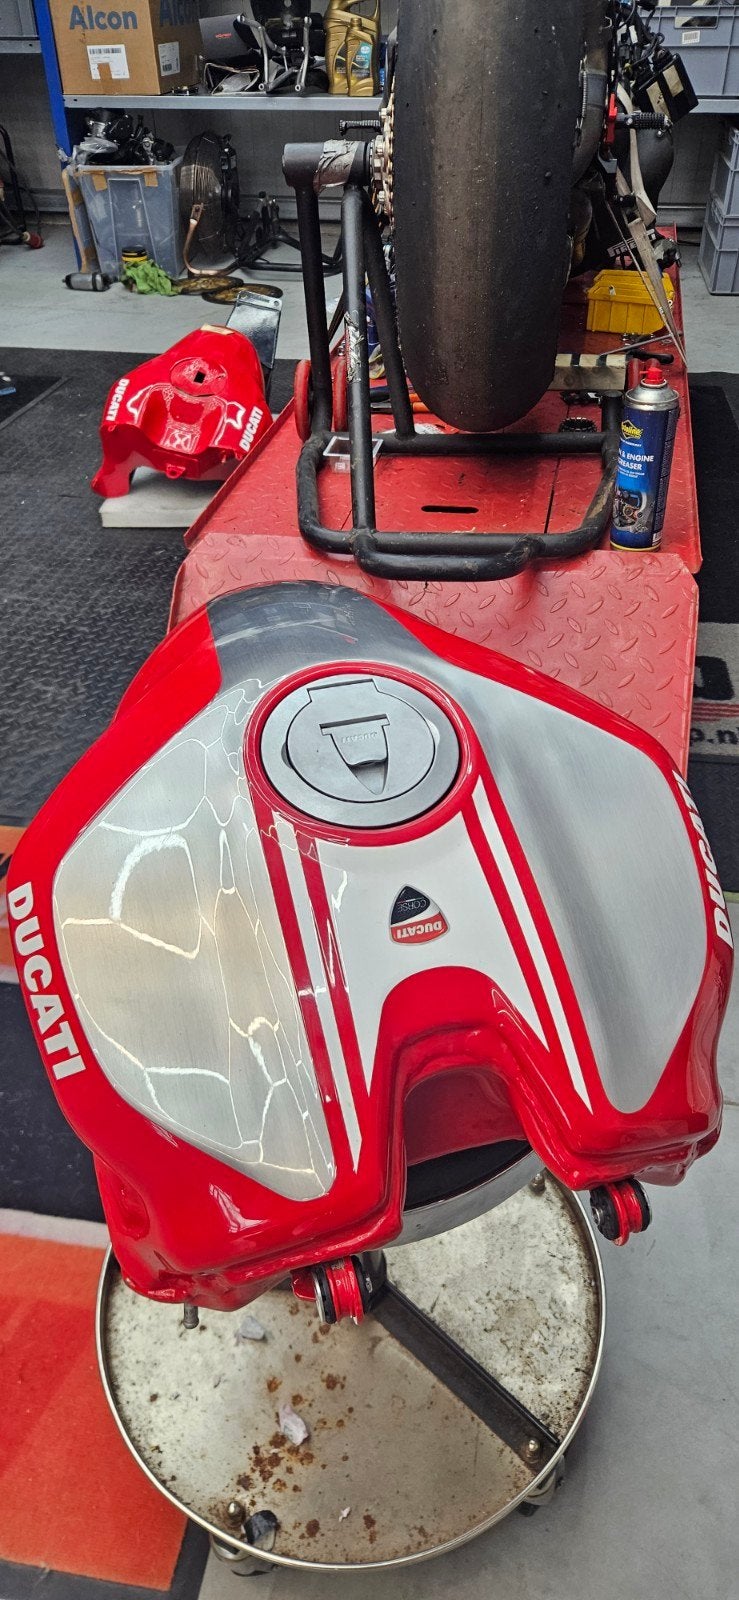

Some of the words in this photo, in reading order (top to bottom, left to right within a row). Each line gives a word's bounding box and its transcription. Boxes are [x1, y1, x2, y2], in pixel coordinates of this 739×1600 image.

[69, 5, 138, 30] Alcon
[106, 379, 130, 421] DUCATI
[239, 406, 263, 452] DUCATI
[626, 453, 654, 462] ENGINE
[398, 900, 427, 912] CORSE
[397, 921, 443, 939] DUCATI
[8, 881, 86, 1080] DUCATI
